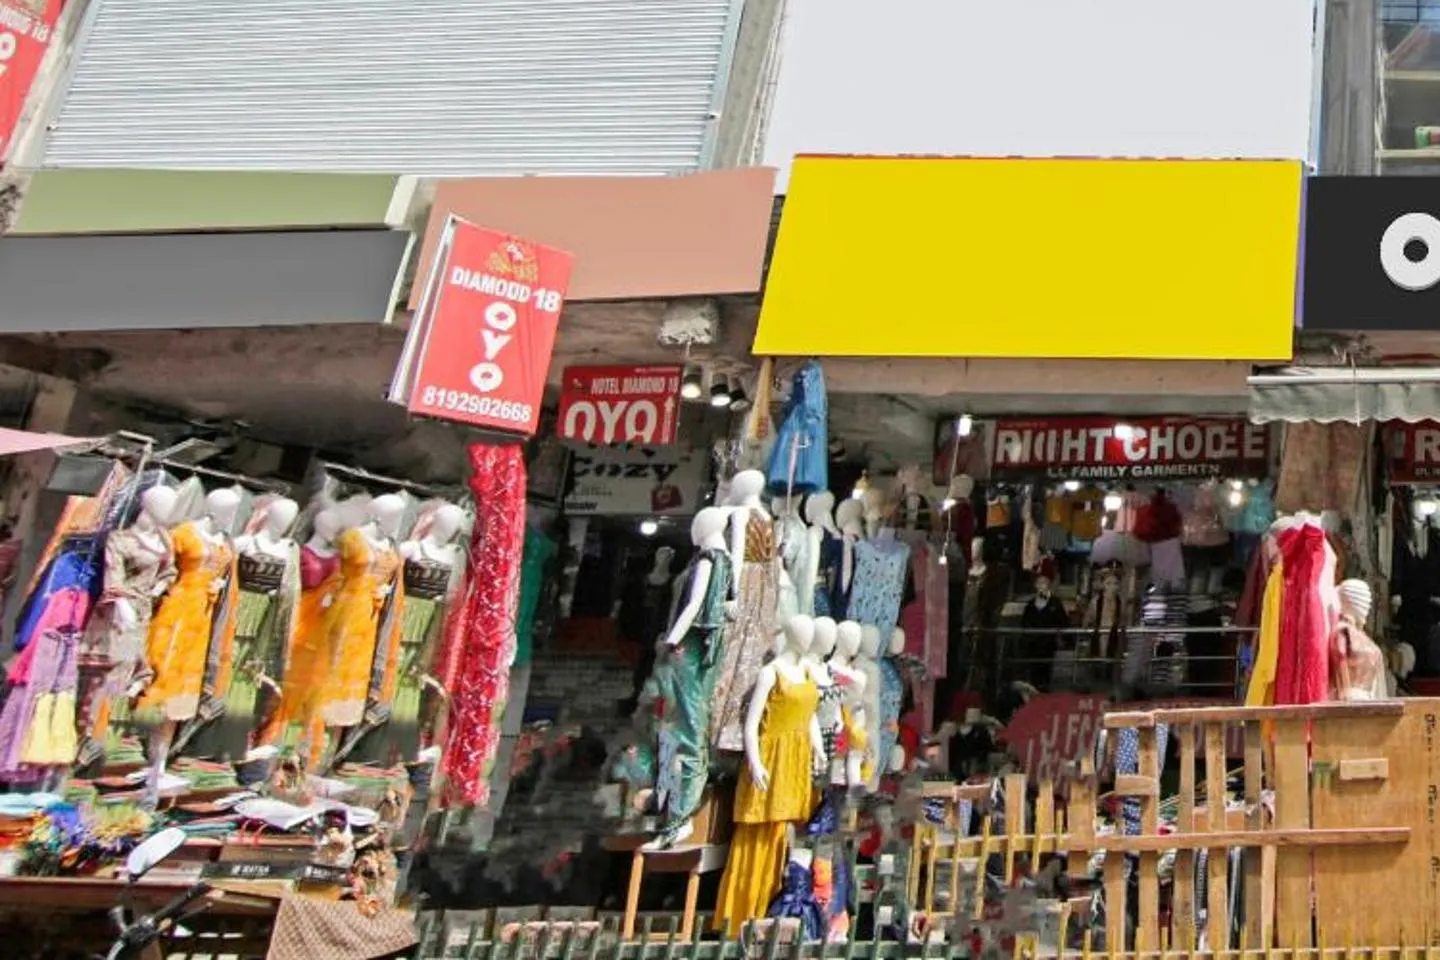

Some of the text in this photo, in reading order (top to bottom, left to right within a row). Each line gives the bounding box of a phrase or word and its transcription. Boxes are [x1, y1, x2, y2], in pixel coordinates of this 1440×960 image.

[533, 287, 562, 314] 18
[469, 300, 518, 393] OYO
[1071, 466, 1127, 478] FAMILY
